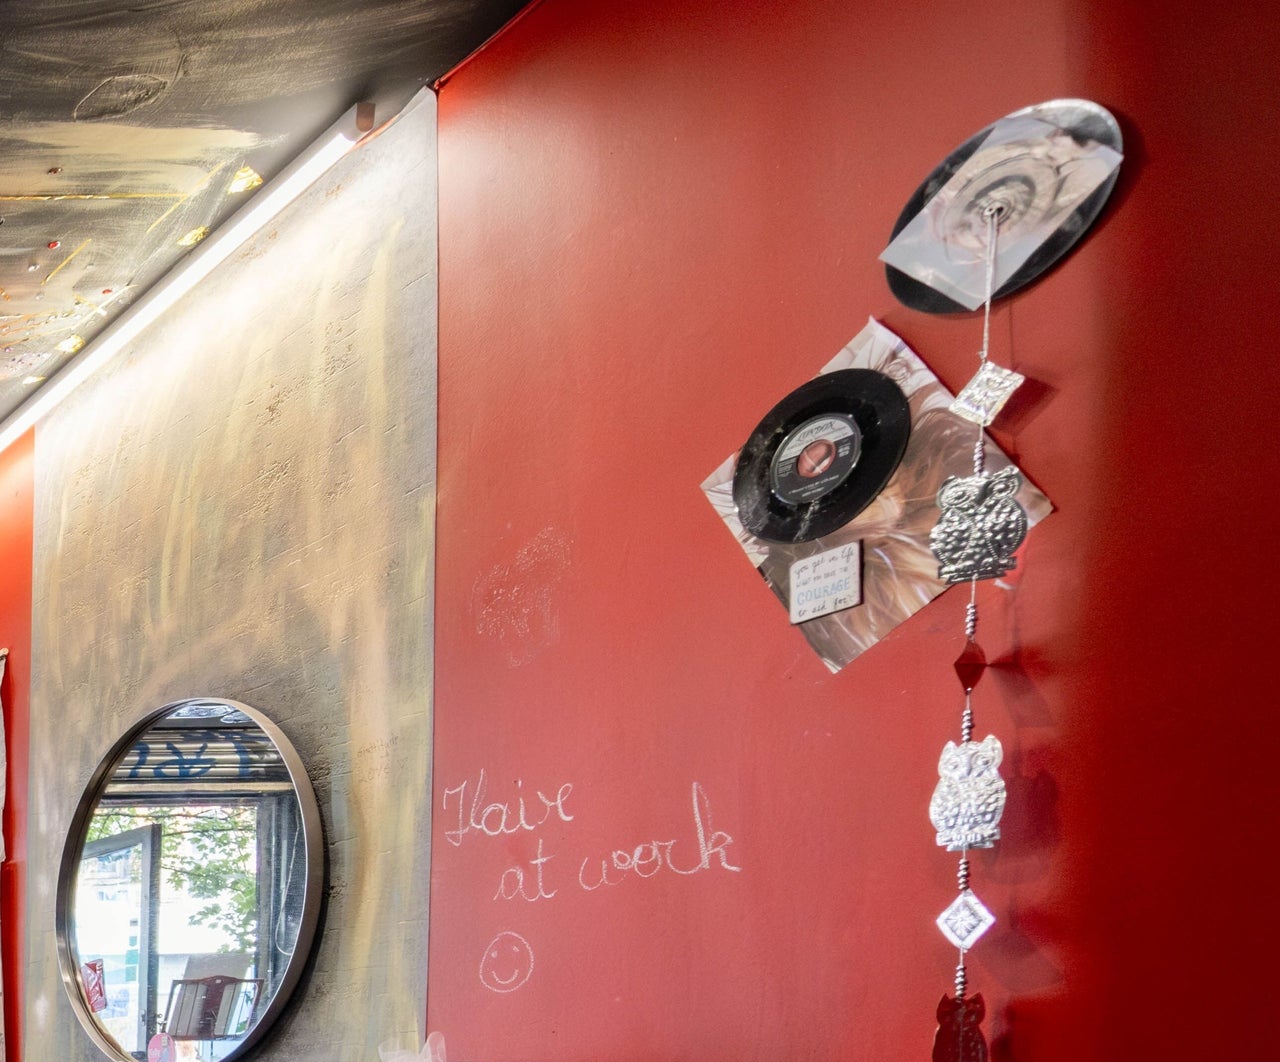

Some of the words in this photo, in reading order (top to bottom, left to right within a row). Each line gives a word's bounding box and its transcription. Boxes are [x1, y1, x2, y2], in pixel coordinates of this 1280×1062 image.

[797, 577, 850, 606] COURAGE
[493, 838, 558, 902] at
[579, 781, 742, 890] work
